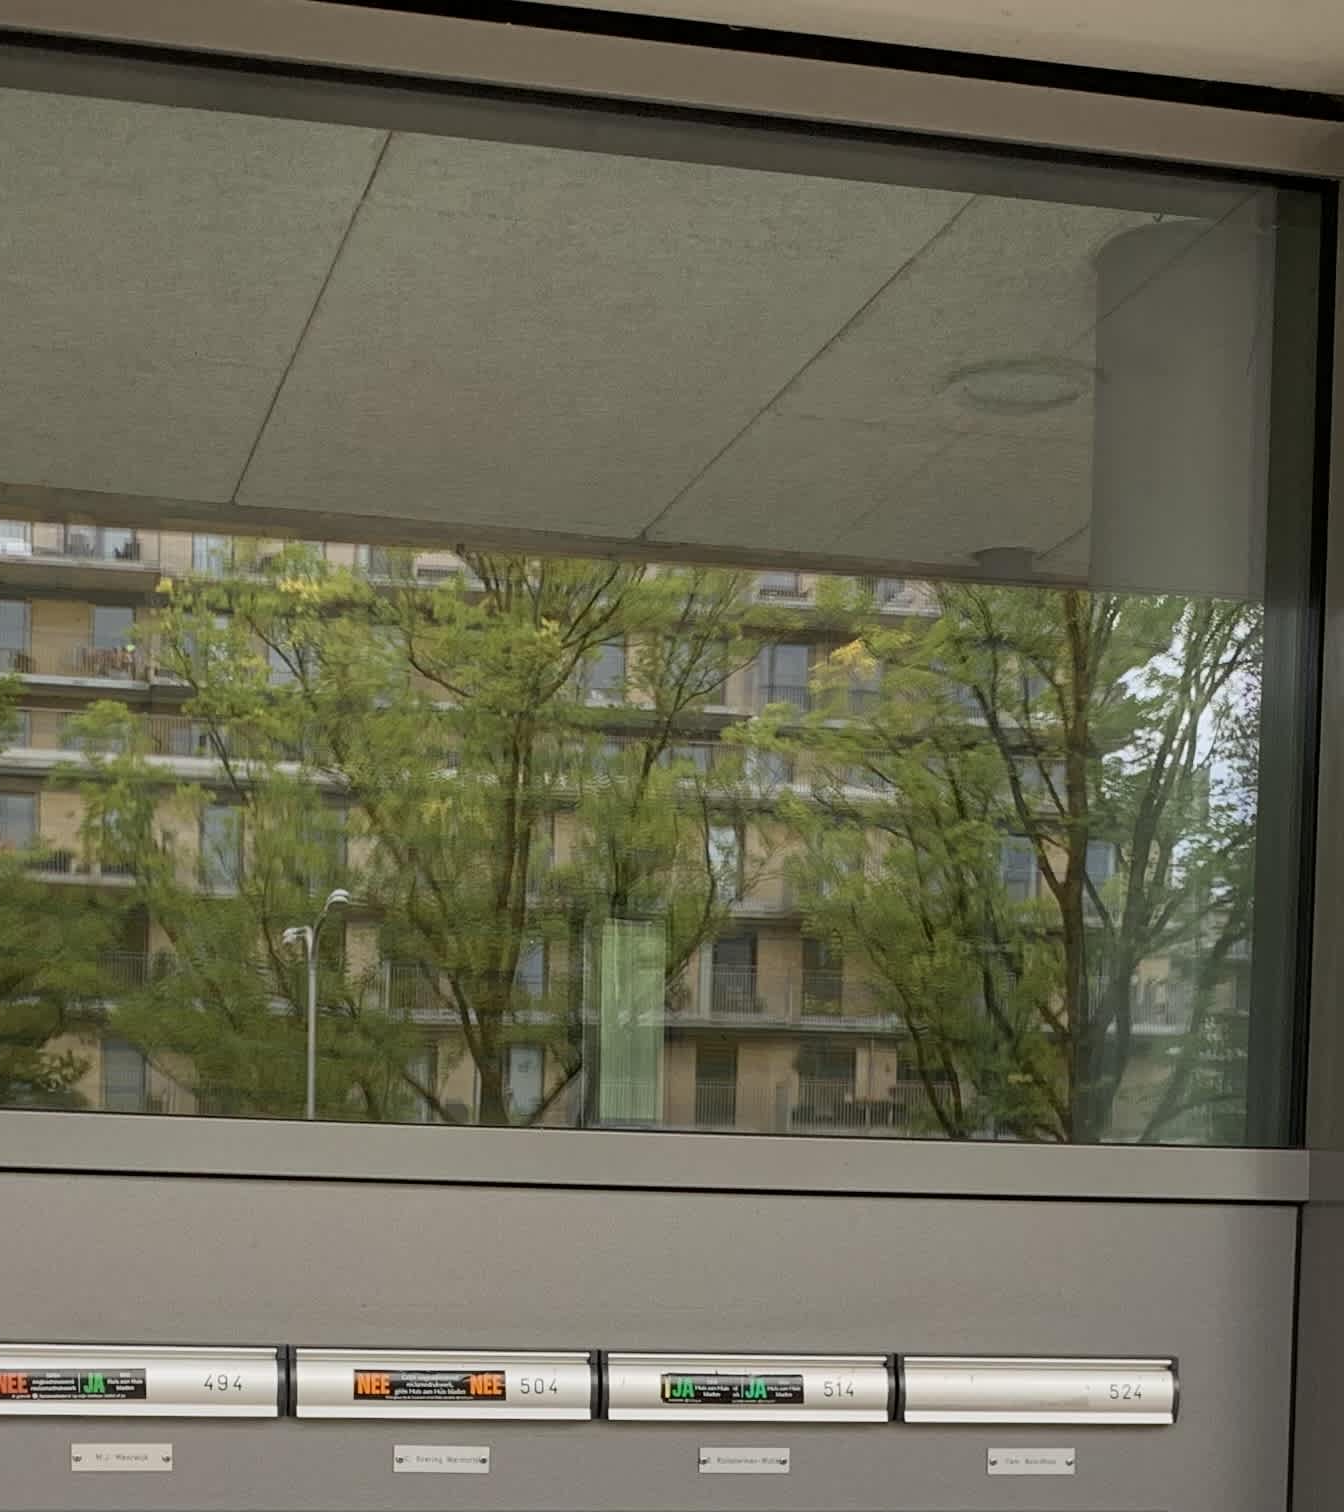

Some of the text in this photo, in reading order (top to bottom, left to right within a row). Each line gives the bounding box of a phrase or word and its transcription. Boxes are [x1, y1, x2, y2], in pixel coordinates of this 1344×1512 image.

[84, 1373, 105, 1393] JA
[203, 1374, 243, 1392] 494
[357, 1375, 390, 1395] NEE
[469, 1374, 503, 1395] NEE
[519, 1377, 559, 1395] 504
[672, 1377, 694, 1398] JA
[745, 1377, 767, 1398] JA
[823, 1380, 854, 1398] 514
[1109, 1384, 1142, 1400] 524
